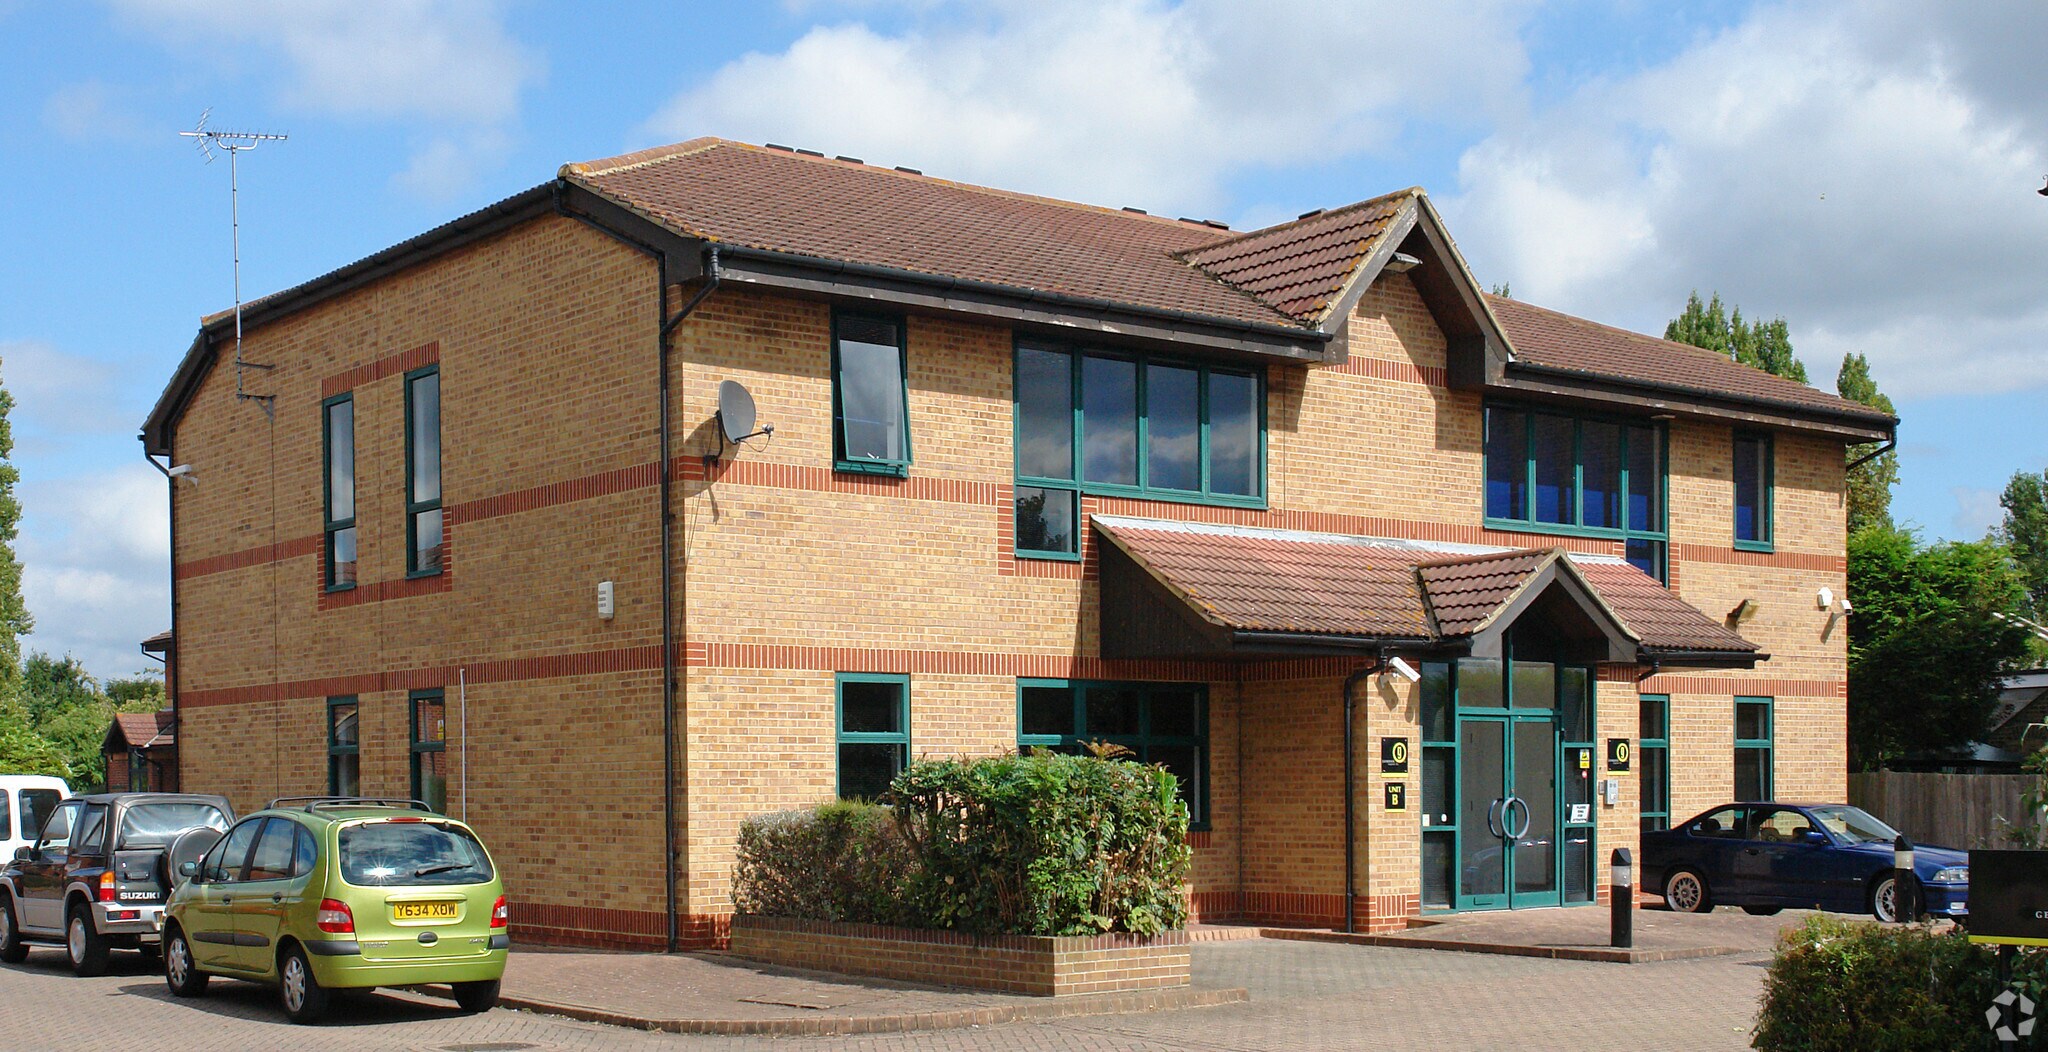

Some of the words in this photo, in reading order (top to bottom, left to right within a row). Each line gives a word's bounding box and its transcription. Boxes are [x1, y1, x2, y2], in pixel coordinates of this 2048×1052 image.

[1392, 794, 1399, 805] B
[120, 892, 160, 900] SUZUKI
[396, 903, 429, 917] Y634
[432, 903, 456, 916] XOW
